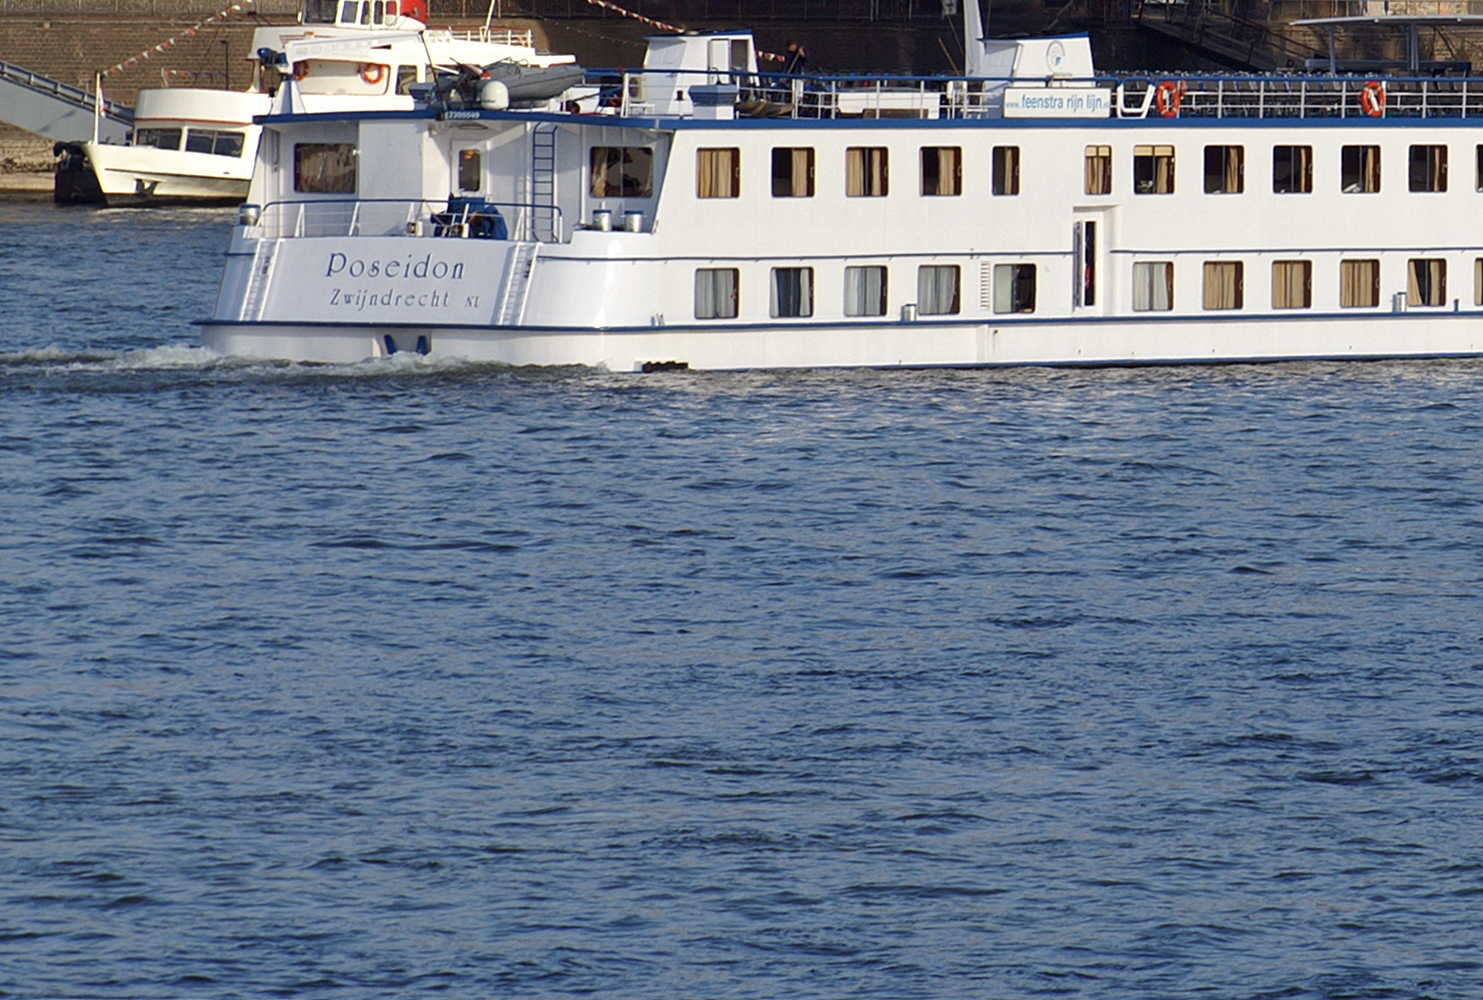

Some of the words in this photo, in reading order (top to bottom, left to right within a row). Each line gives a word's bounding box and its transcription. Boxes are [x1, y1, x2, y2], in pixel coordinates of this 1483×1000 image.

[325, 252, 464, 279] Poseidon
[330, 288, 449, 311] Zwijndrecht
[464, 295, 481, 309] NL
